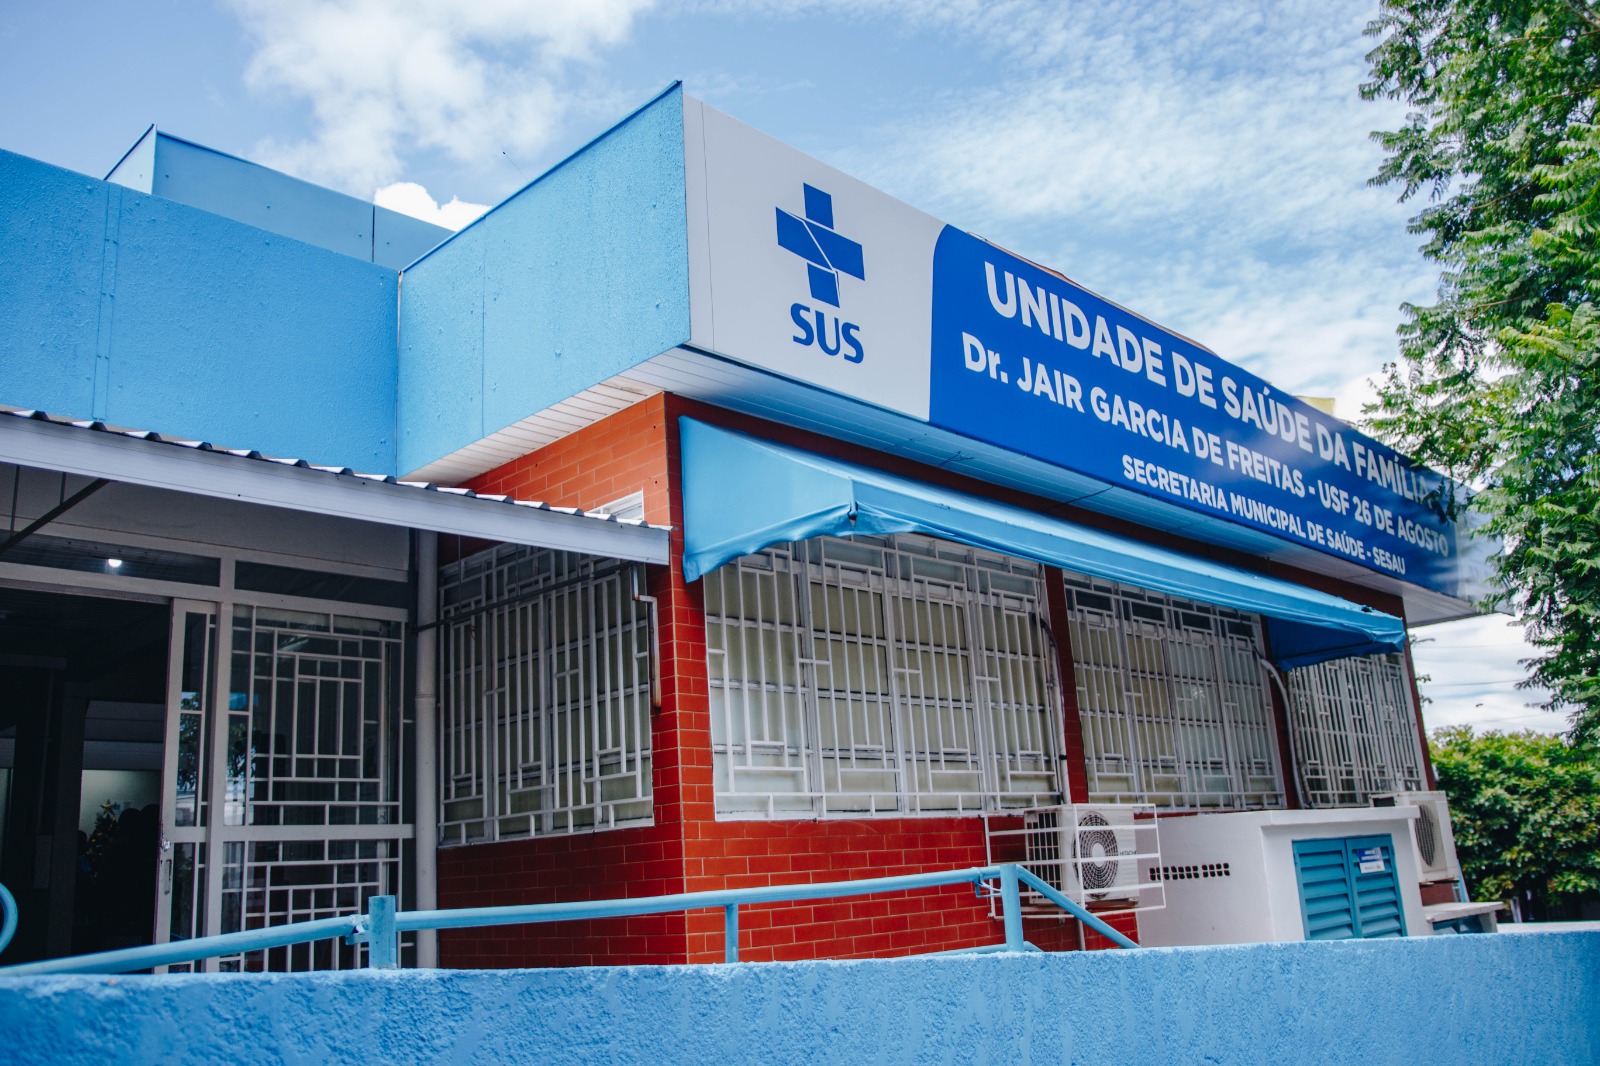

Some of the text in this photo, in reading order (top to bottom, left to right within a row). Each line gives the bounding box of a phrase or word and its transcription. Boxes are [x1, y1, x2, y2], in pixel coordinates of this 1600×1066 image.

[790, 303, 864, 364] SUS
[984, 261, 1167, 387] UNIDADE
[1172, 351, 1217, 409] DE
[1221, 376, 1313, 453] SAÚDE
[1315, 422, 1351, 471] DA
[962, 331, 1449, 557] Dr. JAIR GARCIA DE FREITAS - USF 26 DE AGOSTO
[1122, 454, 1229, 512] SECRETARIA
[1229, 492, 1306, 539] MUNICIPAL
[1307, 520, 1326, 545] DE
[1326, 529, 1366, 560] SAÚDE
[1372, 546, 1406, 575] SESAU
